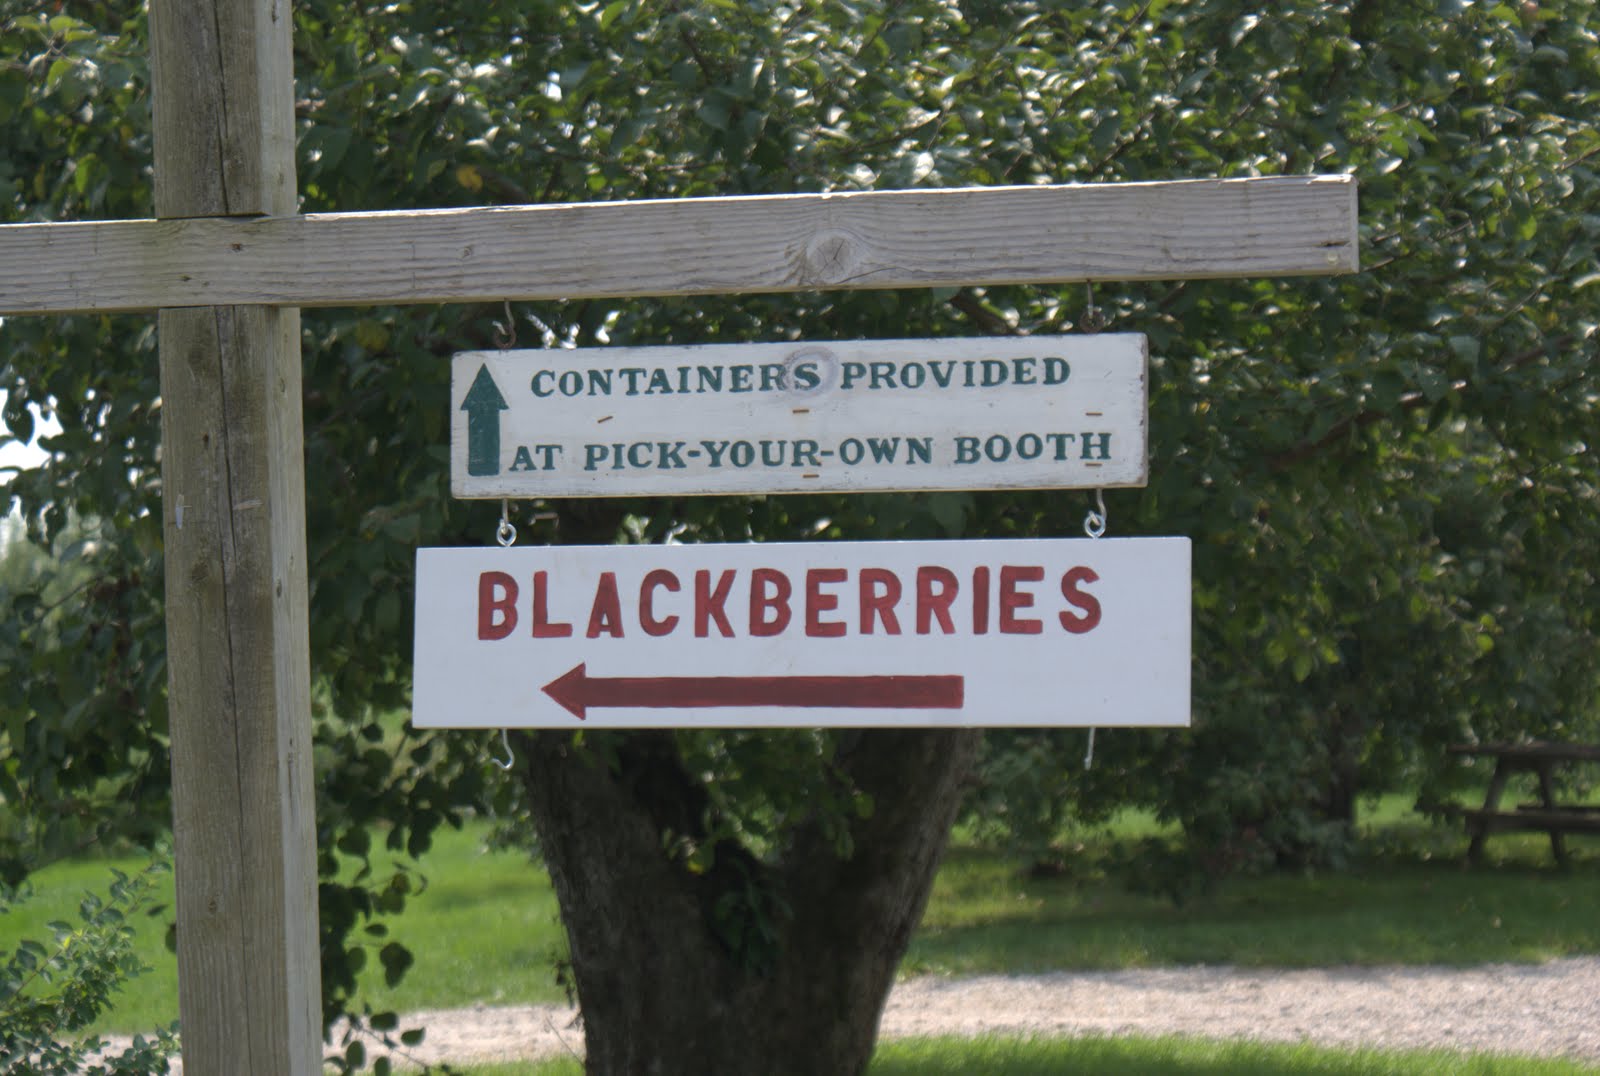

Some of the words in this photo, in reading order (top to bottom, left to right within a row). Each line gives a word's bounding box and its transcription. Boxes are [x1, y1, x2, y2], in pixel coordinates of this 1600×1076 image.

[530, 363, 821, 398] CONTAINERS
[840, 357, 1071, 390] PROVIDED
[508, 444, 563, 472] AT
[584, 437, 934, 471] PICK-YOUR-OWN
[953, 432, 1112, 465] BOOTH
[477, 565, 1102, 641] BLACKBERRIES
